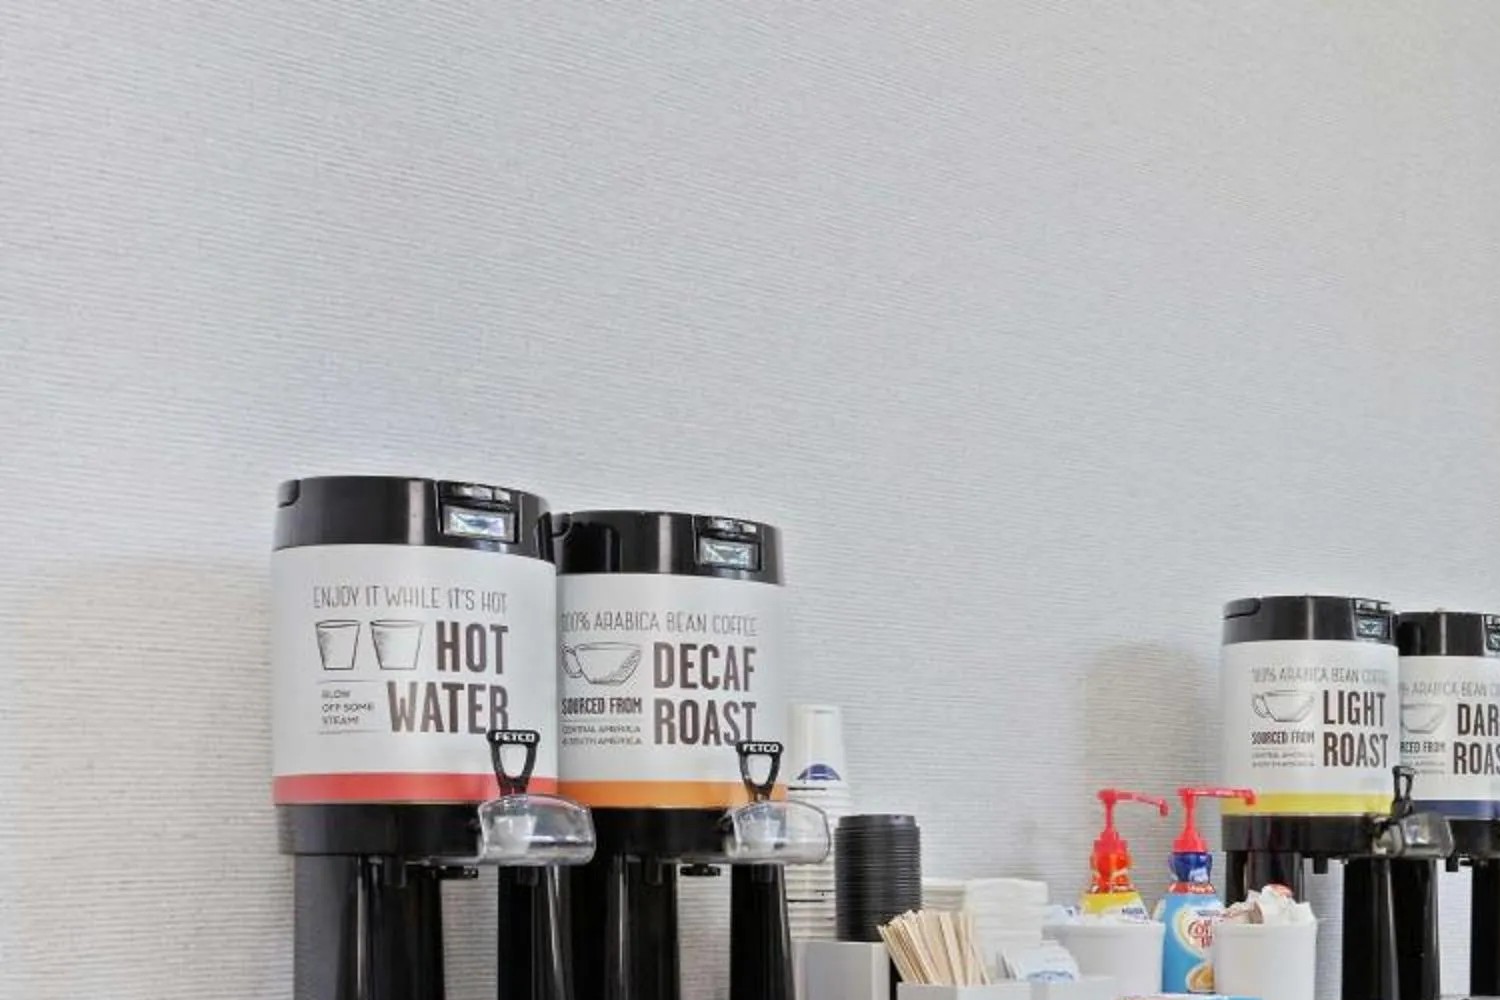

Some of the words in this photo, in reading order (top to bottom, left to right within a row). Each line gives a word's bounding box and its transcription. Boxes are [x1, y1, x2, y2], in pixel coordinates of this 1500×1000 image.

[313, 585, 360, 609] ENJOY
[365, 585, 381, 608] IT
[384, 586, 441, 609] WHILE
[448, 587, 476, 611] IT'S
[481, 591, 508, 614] HOT
[593, 611, 660, 632] ARABICA
[666, 613, 707, 633] BEAN
[712, 615, 758, 637] COFFEE
[435, 620, 509, 675] HOT
[653, 641, 758, 692] DECAF
[387, 680, 509, 735] WATER
[561, 697, 605, 716] SOURCED
[609, 697, 643, 715] FROM
[653, 697, 758, 747] ROAST
[1323, 689, 1387, 727] LIGHT
[494, 731, 536, 742] FETCO
[742, 743, 780, 753] FETCO
[1323, 731, 1389, 769] ROAST
